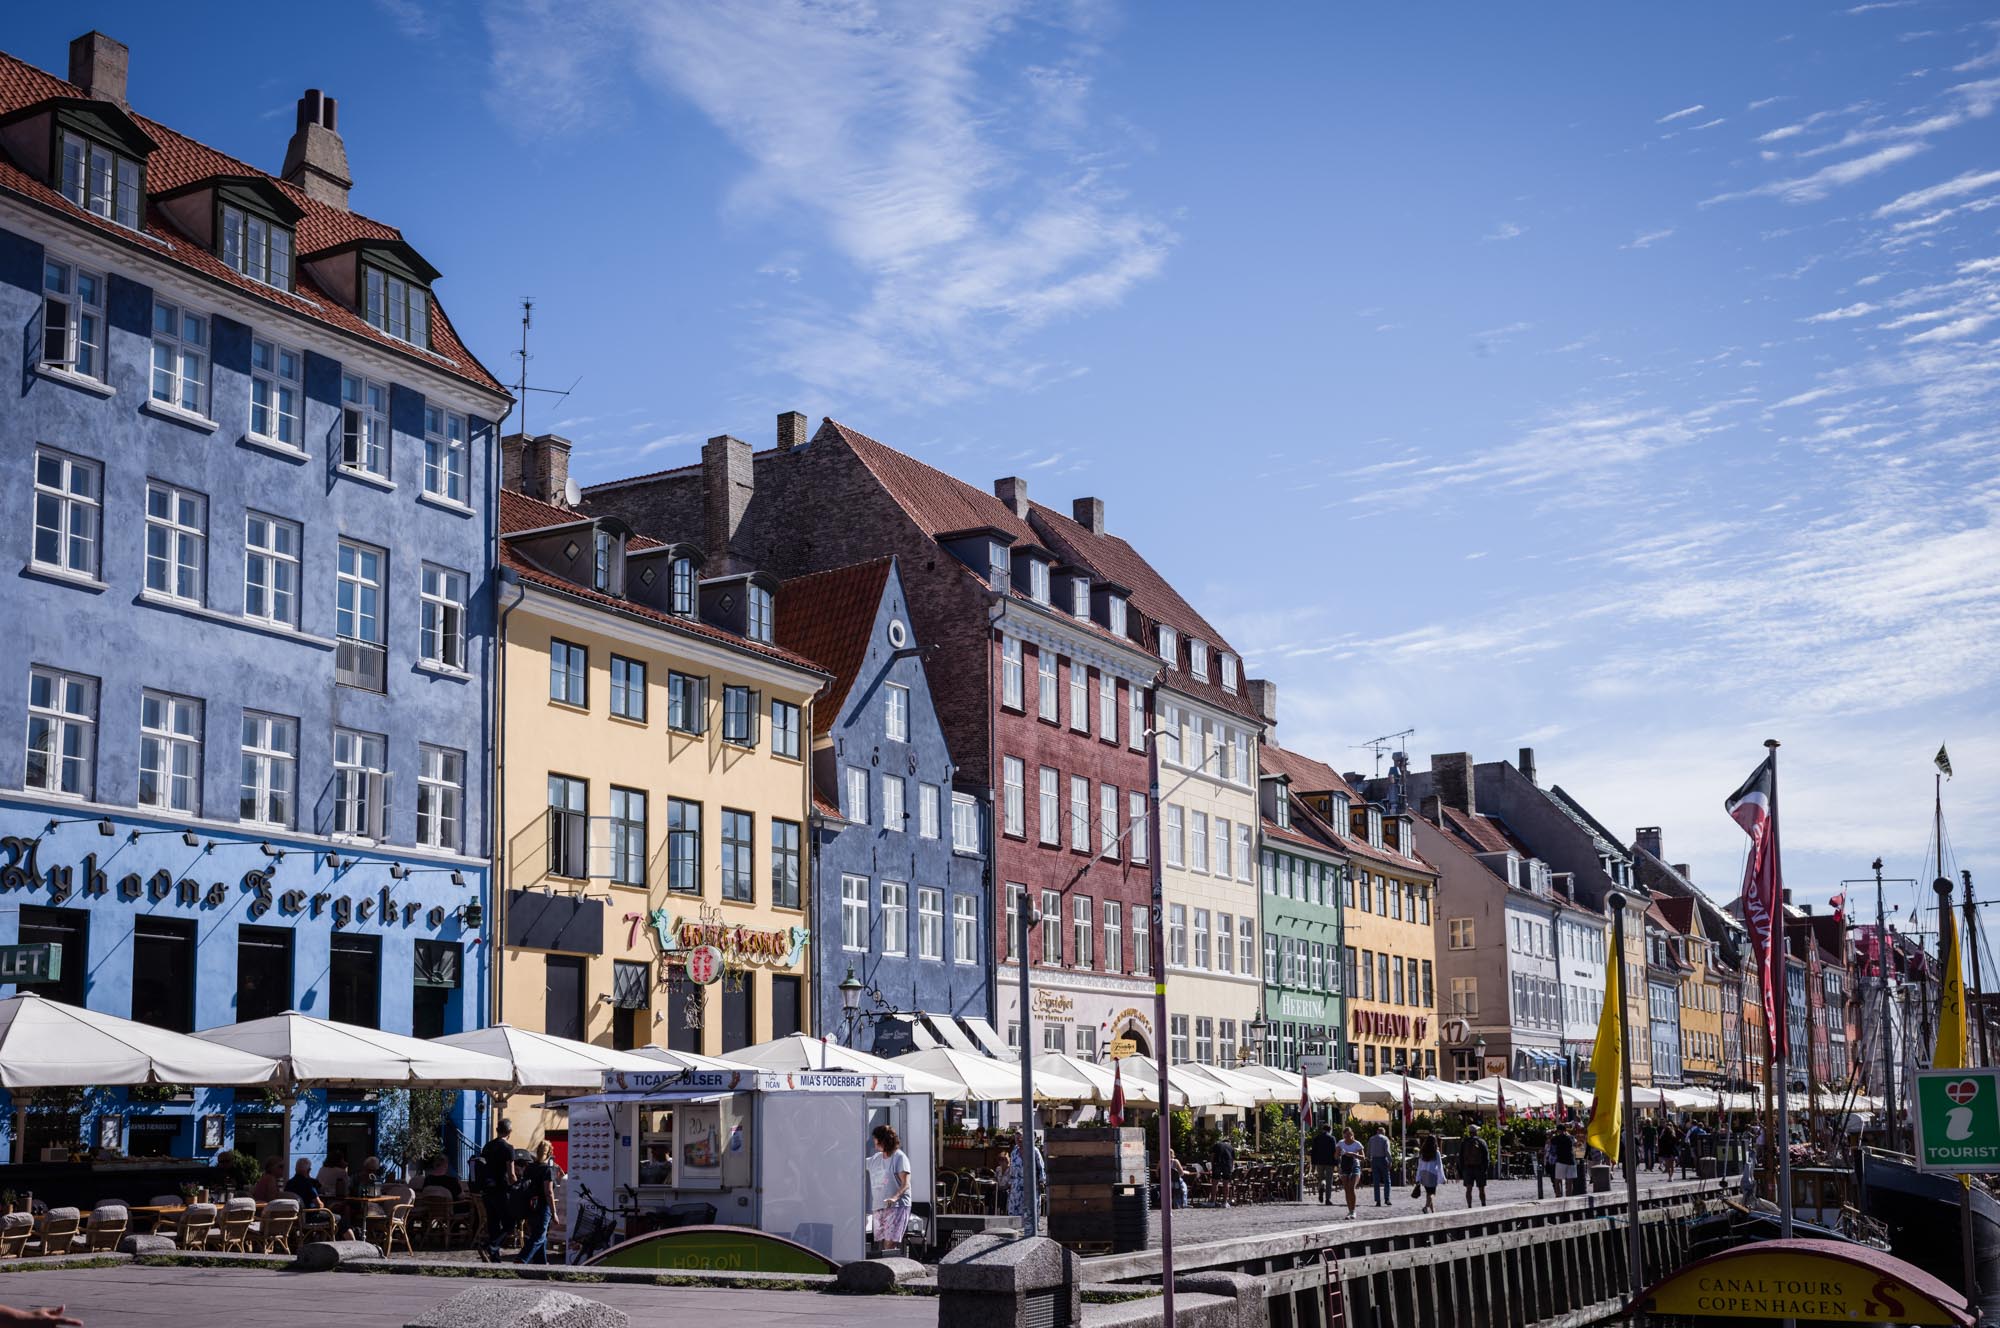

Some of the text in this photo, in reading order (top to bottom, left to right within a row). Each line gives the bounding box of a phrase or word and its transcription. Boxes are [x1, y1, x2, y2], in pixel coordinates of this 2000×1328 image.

[0, 836, 445, 929] Nyhavns Færgekro
[623, 911, 644, 951] 7
[1282, 994, 1325, 1019] HEERING
[1354, 1009, 1428, 1040] NYHAVN 17
[1442, 1021, 1464, 1043] 17
[674, 1074, 722, 1086] ØLSER
[765, 1081, 780, 1089] TICAN
[800, 1075, 821, 1087] MIA'S
[883, 1083, 897, 1091] TICAN
[1927, 1146, 1999, 1158] TOURIST
[715, 1253, 741, 1270] ON
[1698, 1277, 1843, 1296] CANAL TOURS
[1697, 1296, 1847, 1315] COPENHAGEN
